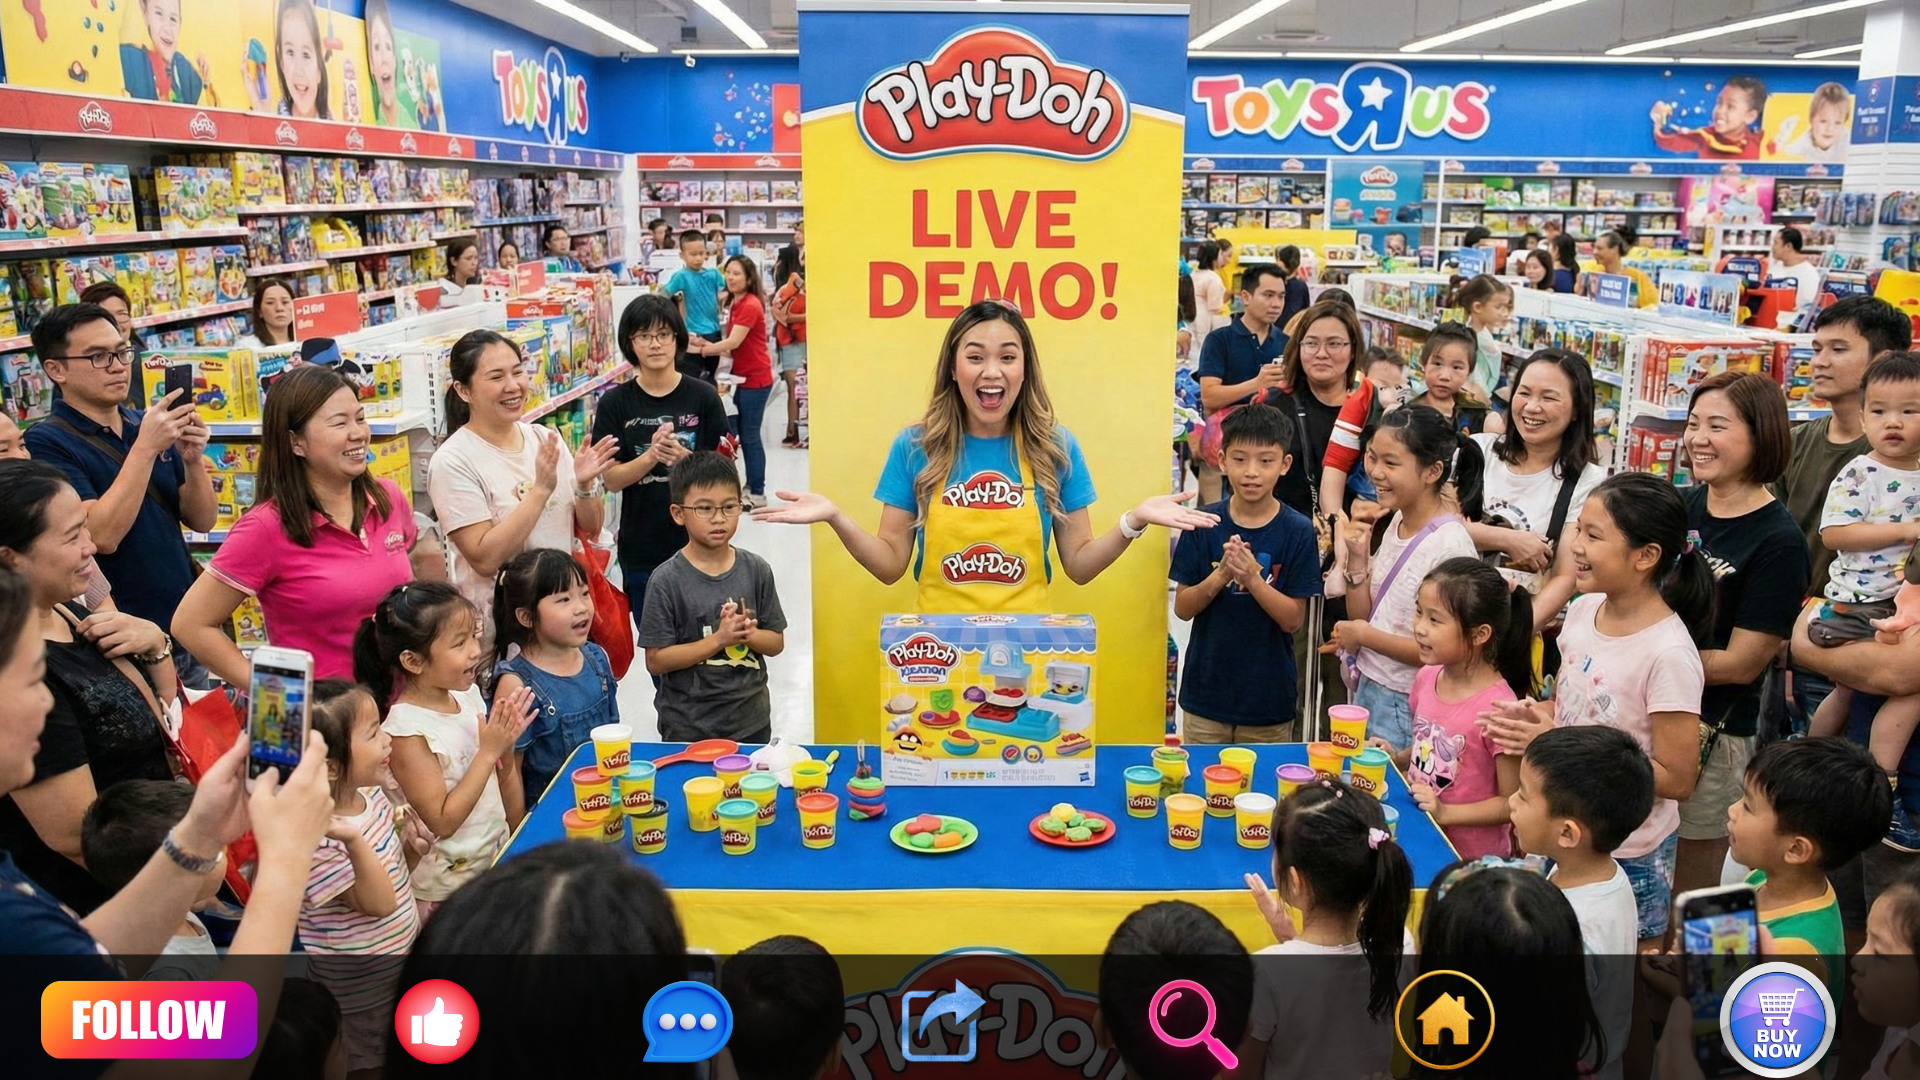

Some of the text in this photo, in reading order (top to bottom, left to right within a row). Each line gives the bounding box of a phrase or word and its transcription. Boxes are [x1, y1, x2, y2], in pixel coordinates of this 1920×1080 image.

[866, 55, 1114, 143] Play-Doh
[913, 190, 1076, 248] LIVE
[869, 261, 1118, 321] DEMO!
[942, 481, 1024, 508] Play-Do
[943, 553, 1022, 580] Play-Doh
[890, 641, 955, 665] Play-Doh
